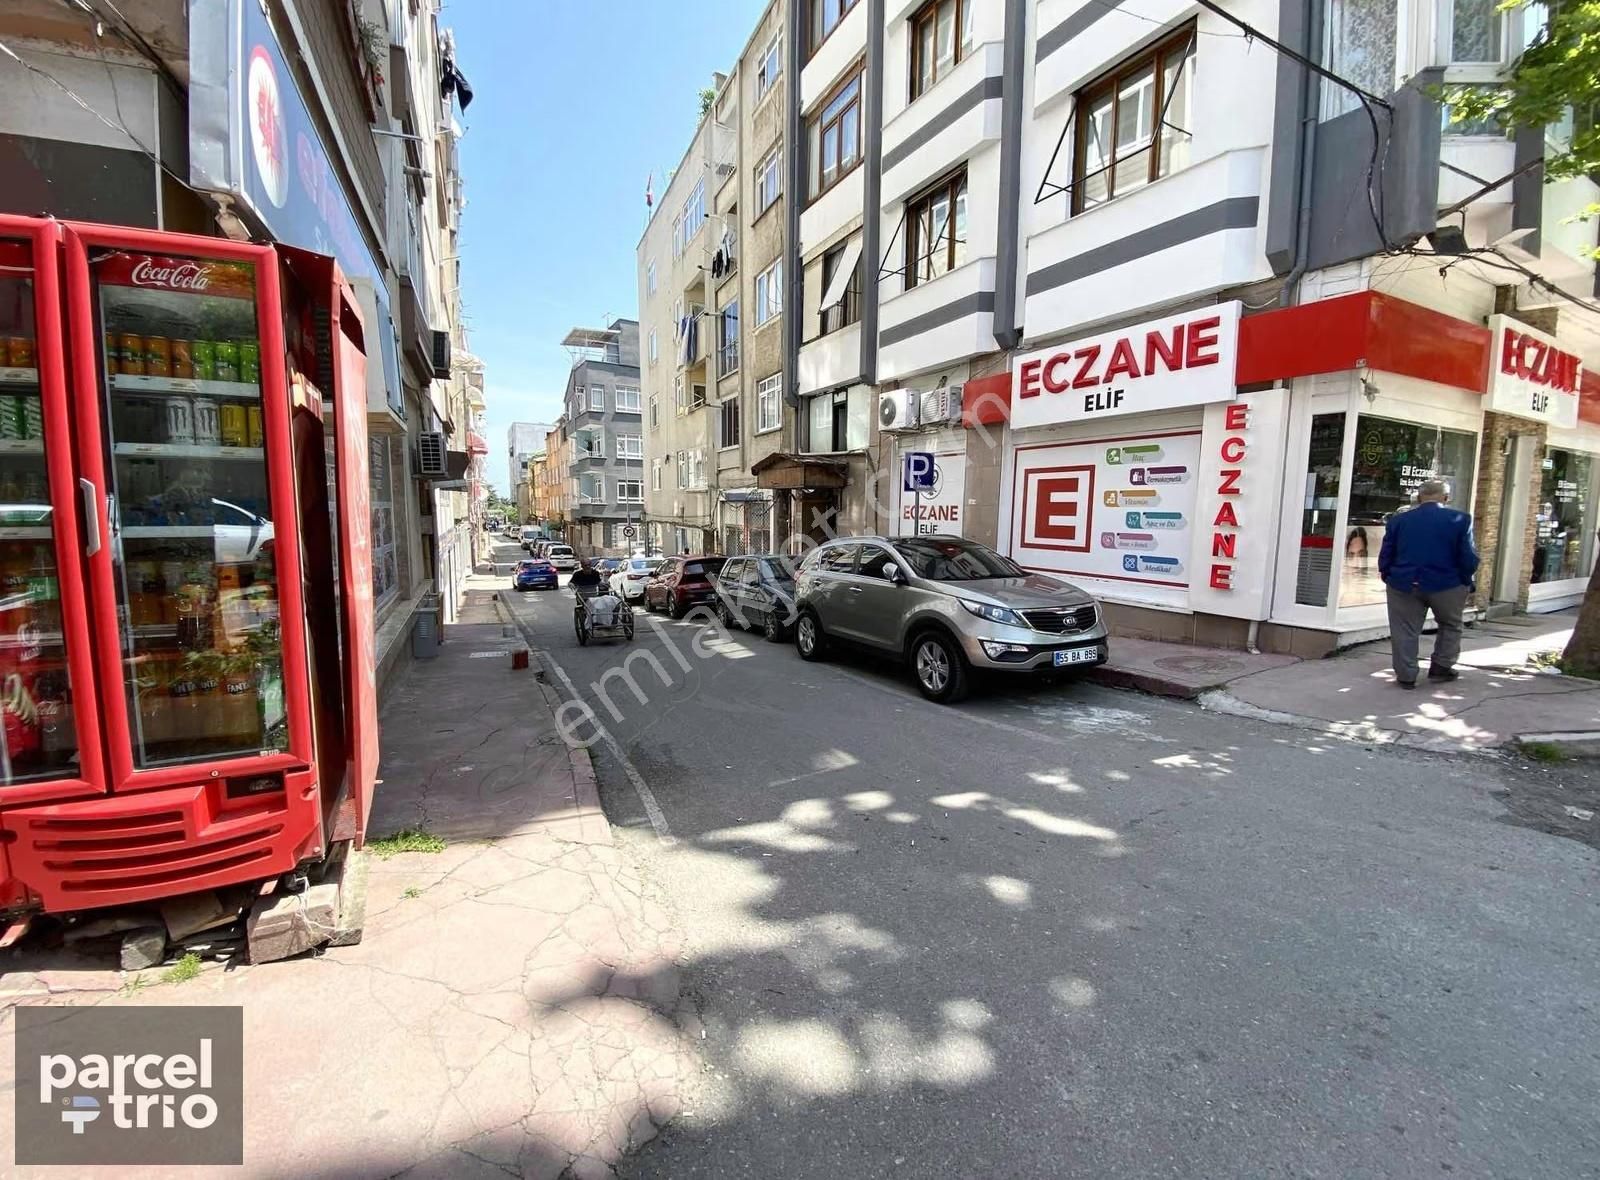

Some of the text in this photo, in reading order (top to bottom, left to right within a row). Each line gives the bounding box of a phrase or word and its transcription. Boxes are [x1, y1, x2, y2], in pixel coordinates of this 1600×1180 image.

[131, 260, 212, 290] Coca-Cola
[1020, 316, 1220, 399] ECZANE
[1501, 327, 1582, 396] ECZANE
[1084, 387, 1125, 412] ELİF
[1532, 391, 1549, 413] ELİF
[1034, 477, 1079, 540] E
[1209, 403, 1250, 590] ECZANE
[919, 523, 939, 534] ELİF
[1060, 653, 1068, 662] 55
[1072, 651, 1080, 661] BA
